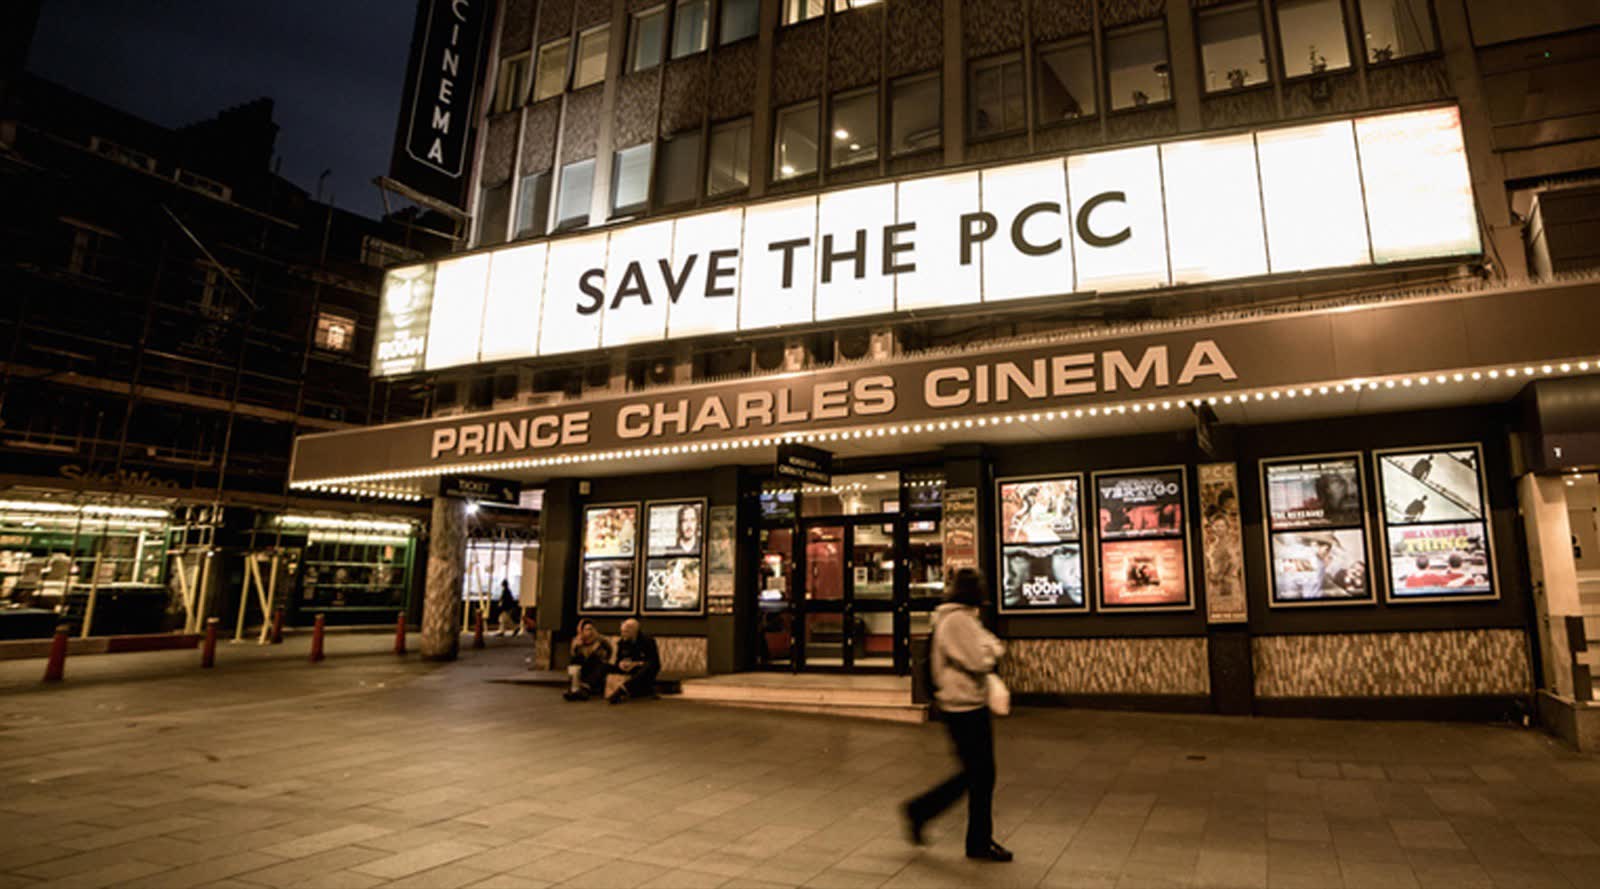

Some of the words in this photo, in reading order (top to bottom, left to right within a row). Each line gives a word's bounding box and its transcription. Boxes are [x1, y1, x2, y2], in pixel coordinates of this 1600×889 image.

[426, 0, 470, 164] CINEMA
[576, 249, 740, 316] SAVE
[768, 221, 917, 288] THE
[959, 191, 1133, 265] PCC
[431, 411, 592, 459] PRINCE
[617, 375, 897, 439] CHARLES
[924, 340, 1239, 408] CINEMA
[1202, 466, 1234, 478] PCC
[1022, 582, 1064, 597] ROOM
